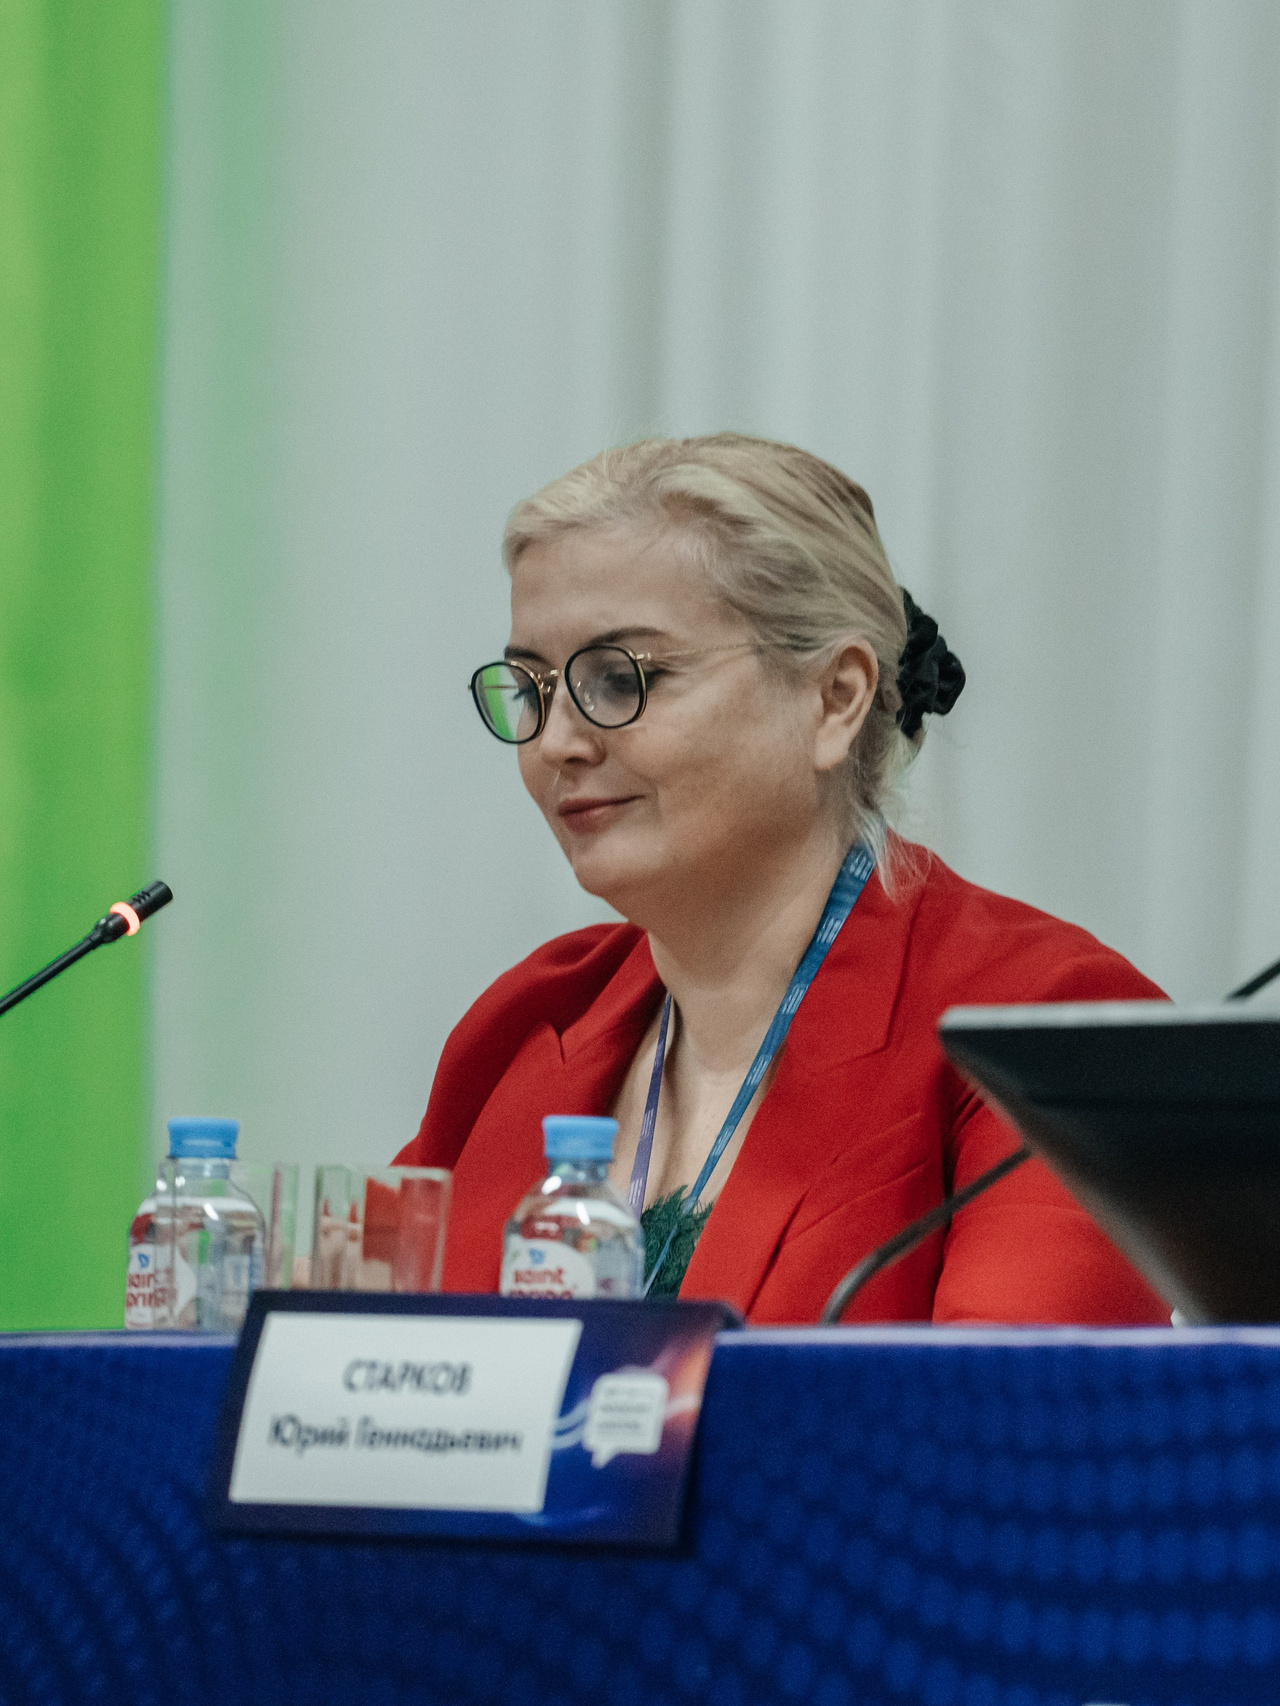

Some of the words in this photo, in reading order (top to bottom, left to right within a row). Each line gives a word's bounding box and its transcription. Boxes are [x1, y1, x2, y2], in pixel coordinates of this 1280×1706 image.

[342, 1359, 473, 1395] СТАРКОВ
[269, 1414, 349, 1457] Юрий
[355, 1416, 522, 1454] Геннадьевич
